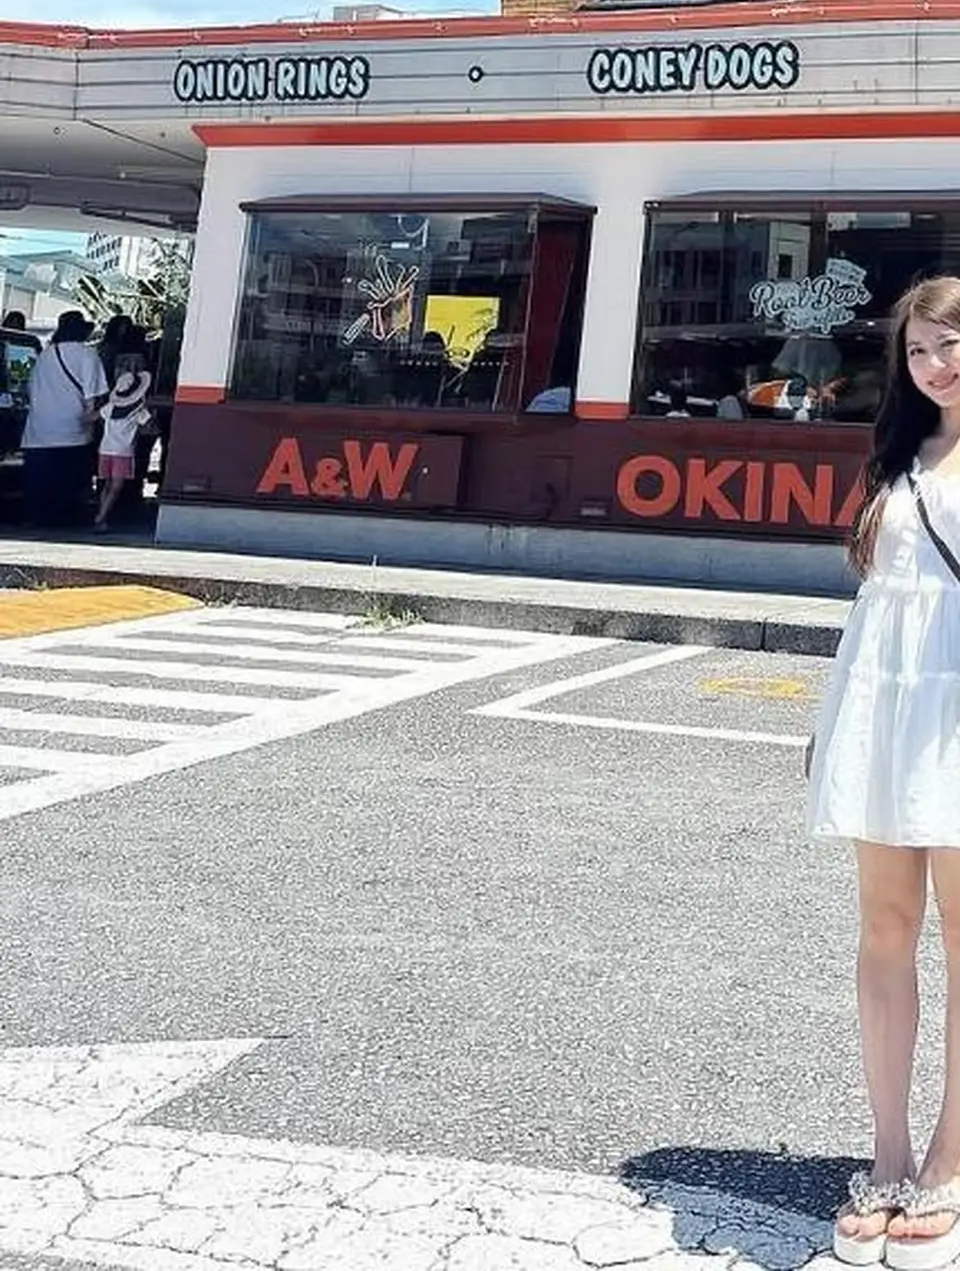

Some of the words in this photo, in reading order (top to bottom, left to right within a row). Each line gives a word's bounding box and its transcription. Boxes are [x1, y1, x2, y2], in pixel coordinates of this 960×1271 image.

[174, 59, 269, 101] ONION
[274, 56, 370, 100] RINGS
[587, 43, 701, 93] CONEY
[703, 41, 800, 90] DOGS
[257, 437, 419, 498] A&W
